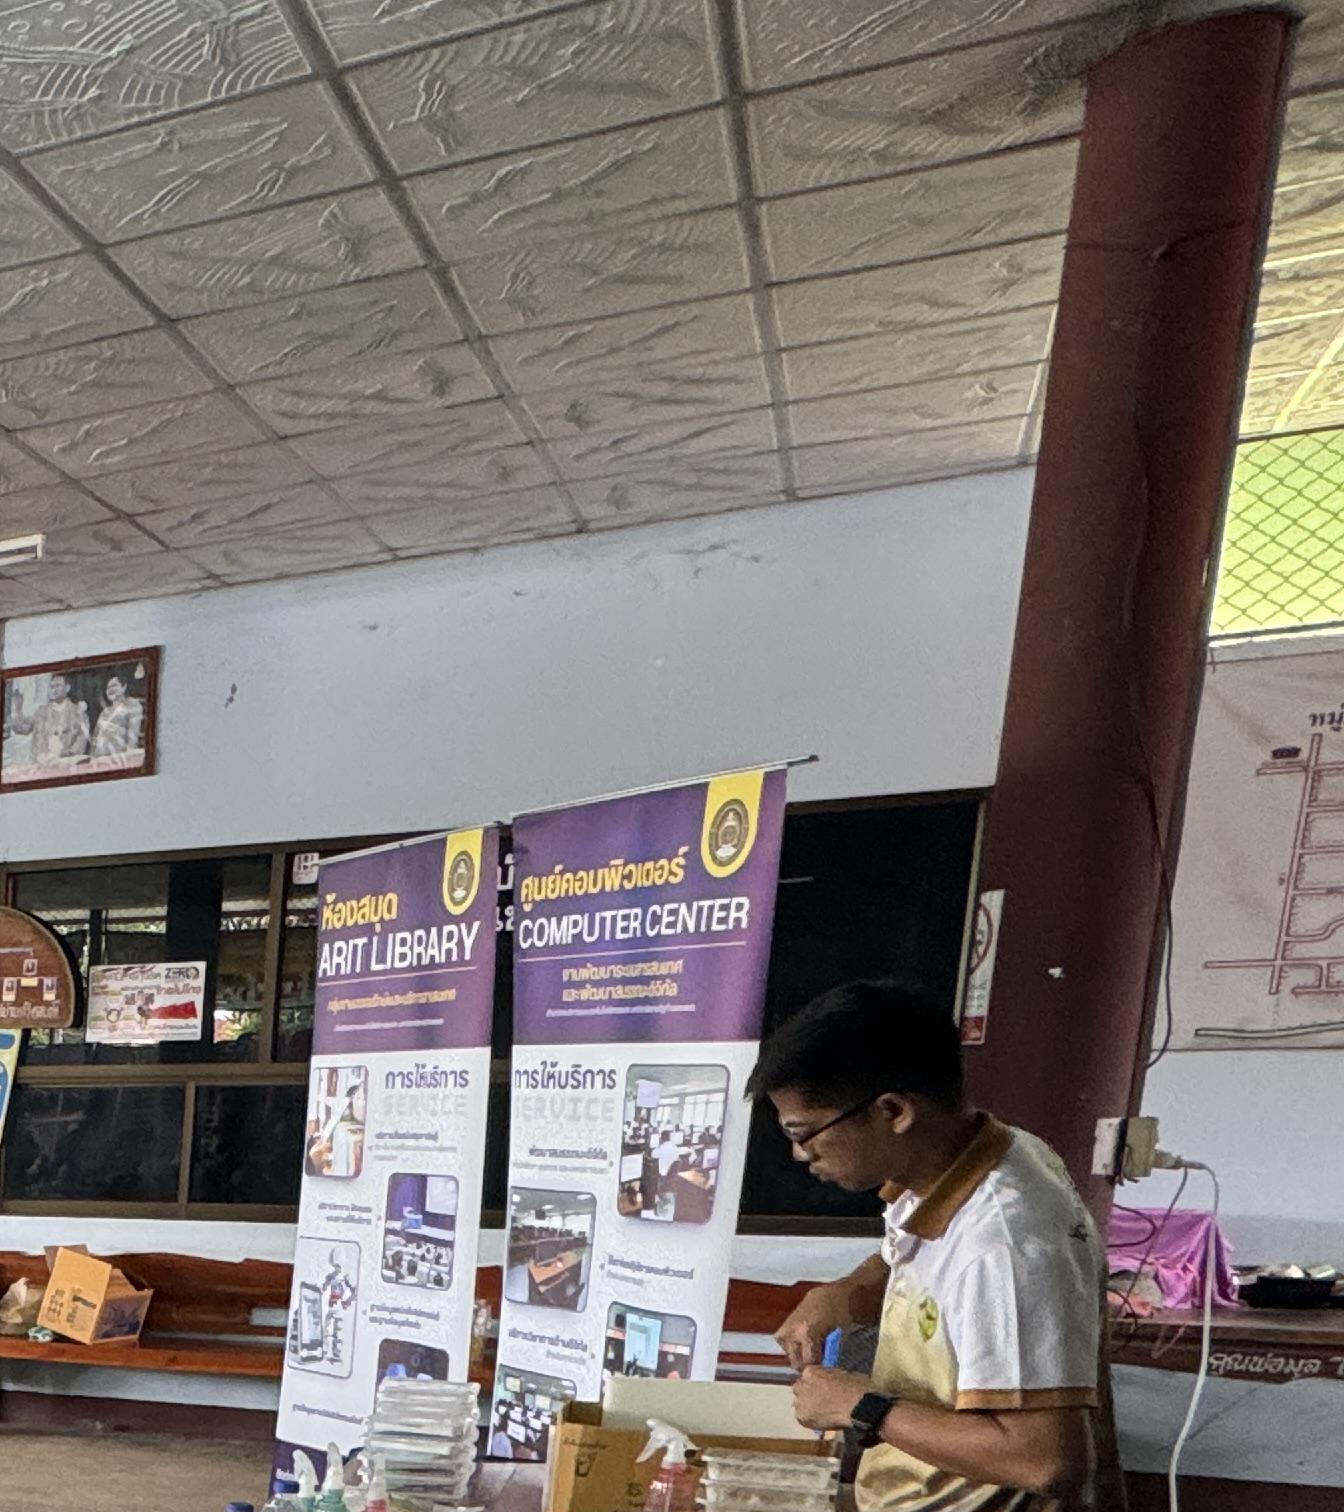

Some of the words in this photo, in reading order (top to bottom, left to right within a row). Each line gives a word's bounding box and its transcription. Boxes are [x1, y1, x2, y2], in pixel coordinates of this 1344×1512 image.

[521, 846, 689, 913] ศูนย์คอมพิวเตอร์
[322, 892, 398, 933] ห้องสมุด
[518, 908, 642, 949] COMPUTER
[644, 897, 750, 937] CENTER
[318, 937, 368, 978] ARIT
[370, 920, 481, 968] LIBRARY
